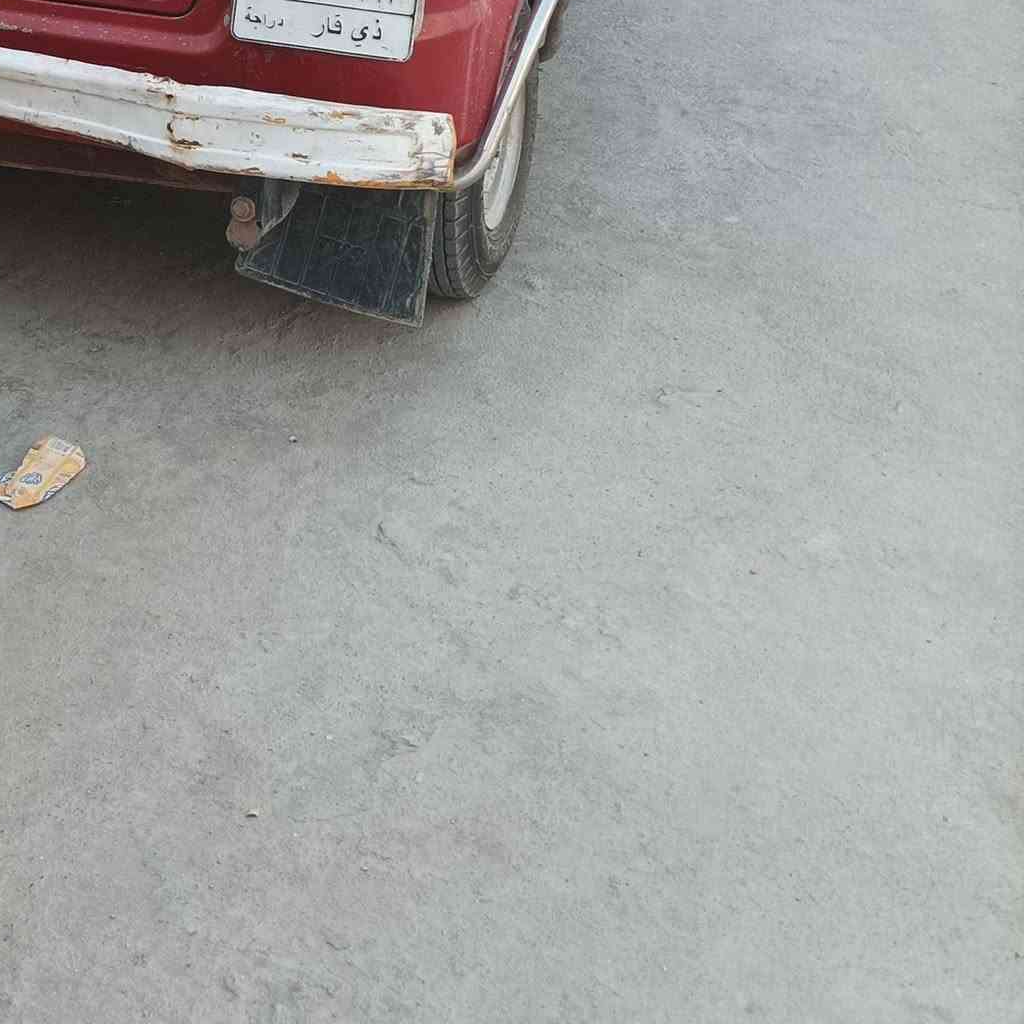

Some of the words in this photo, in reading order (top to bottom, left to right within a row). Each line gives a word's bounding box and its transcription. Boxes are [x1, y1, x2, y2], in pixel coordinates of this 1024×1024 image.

[244, 7, 284, 30] دراجة
[312, 14, 343, 38] قار
[350, 17, 382, 47] ذي
